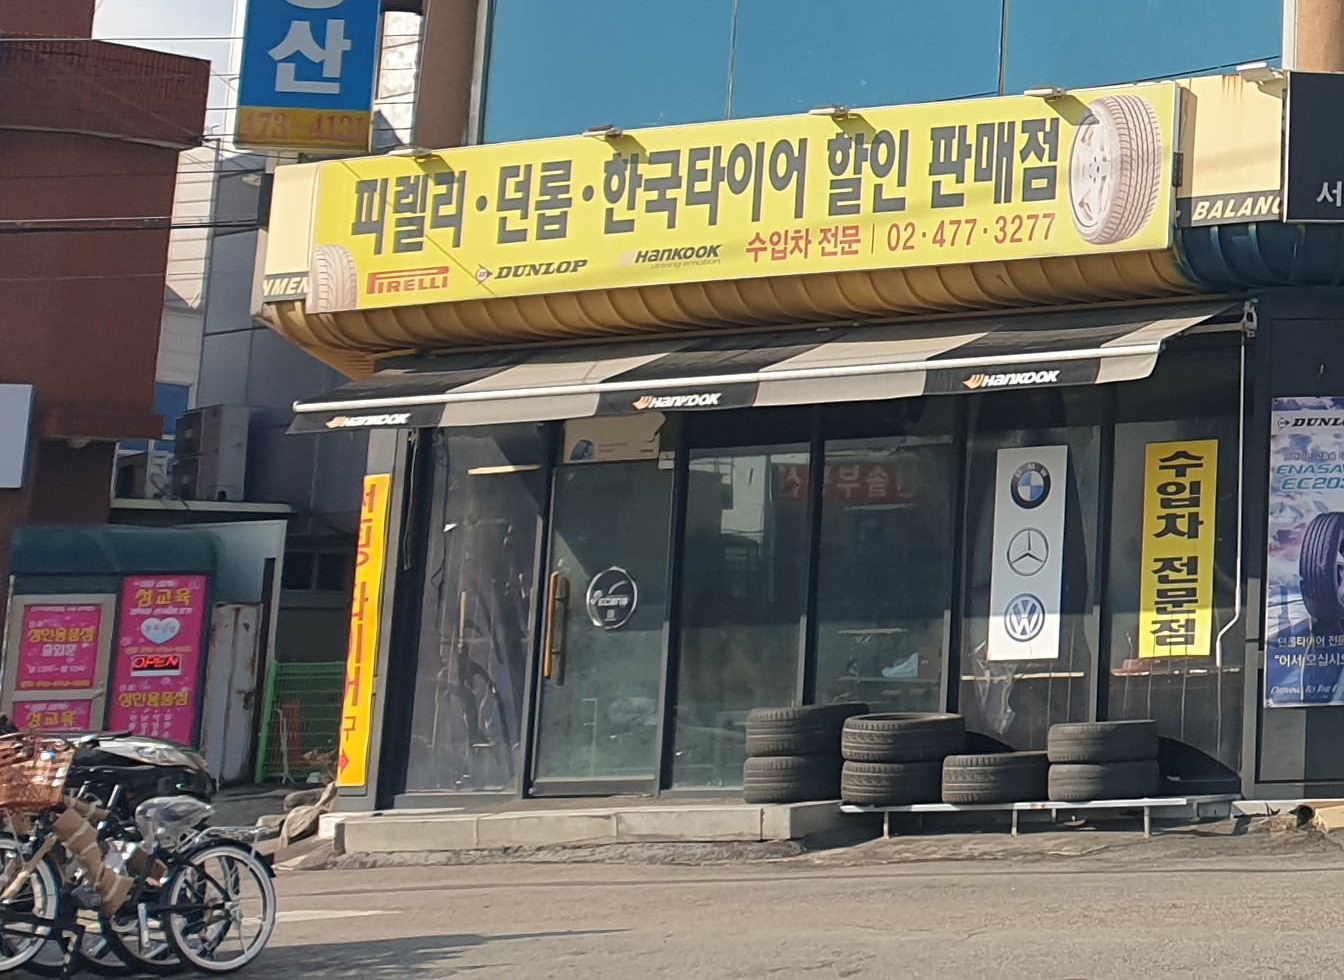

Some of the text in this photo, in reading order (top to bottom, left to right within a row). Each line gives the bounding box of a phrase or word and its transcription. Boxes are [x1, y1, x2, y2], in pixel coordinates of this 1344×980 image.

[603, 136, 809, 235] 한국타이어
[826, 128, 908, 217] 할인
[929, 115, 1061, 211] 판매점
[746, 227, 812, 264] 수입차
[818, 224, 862, 257] 전문
[366, 266, 450, 295] PIRELLI
[494, 259, 588, 280] DUNLOP
[1148, 448, 1205, 648] 수입차 전문점
[132, 654, 179, 669] OPEN
